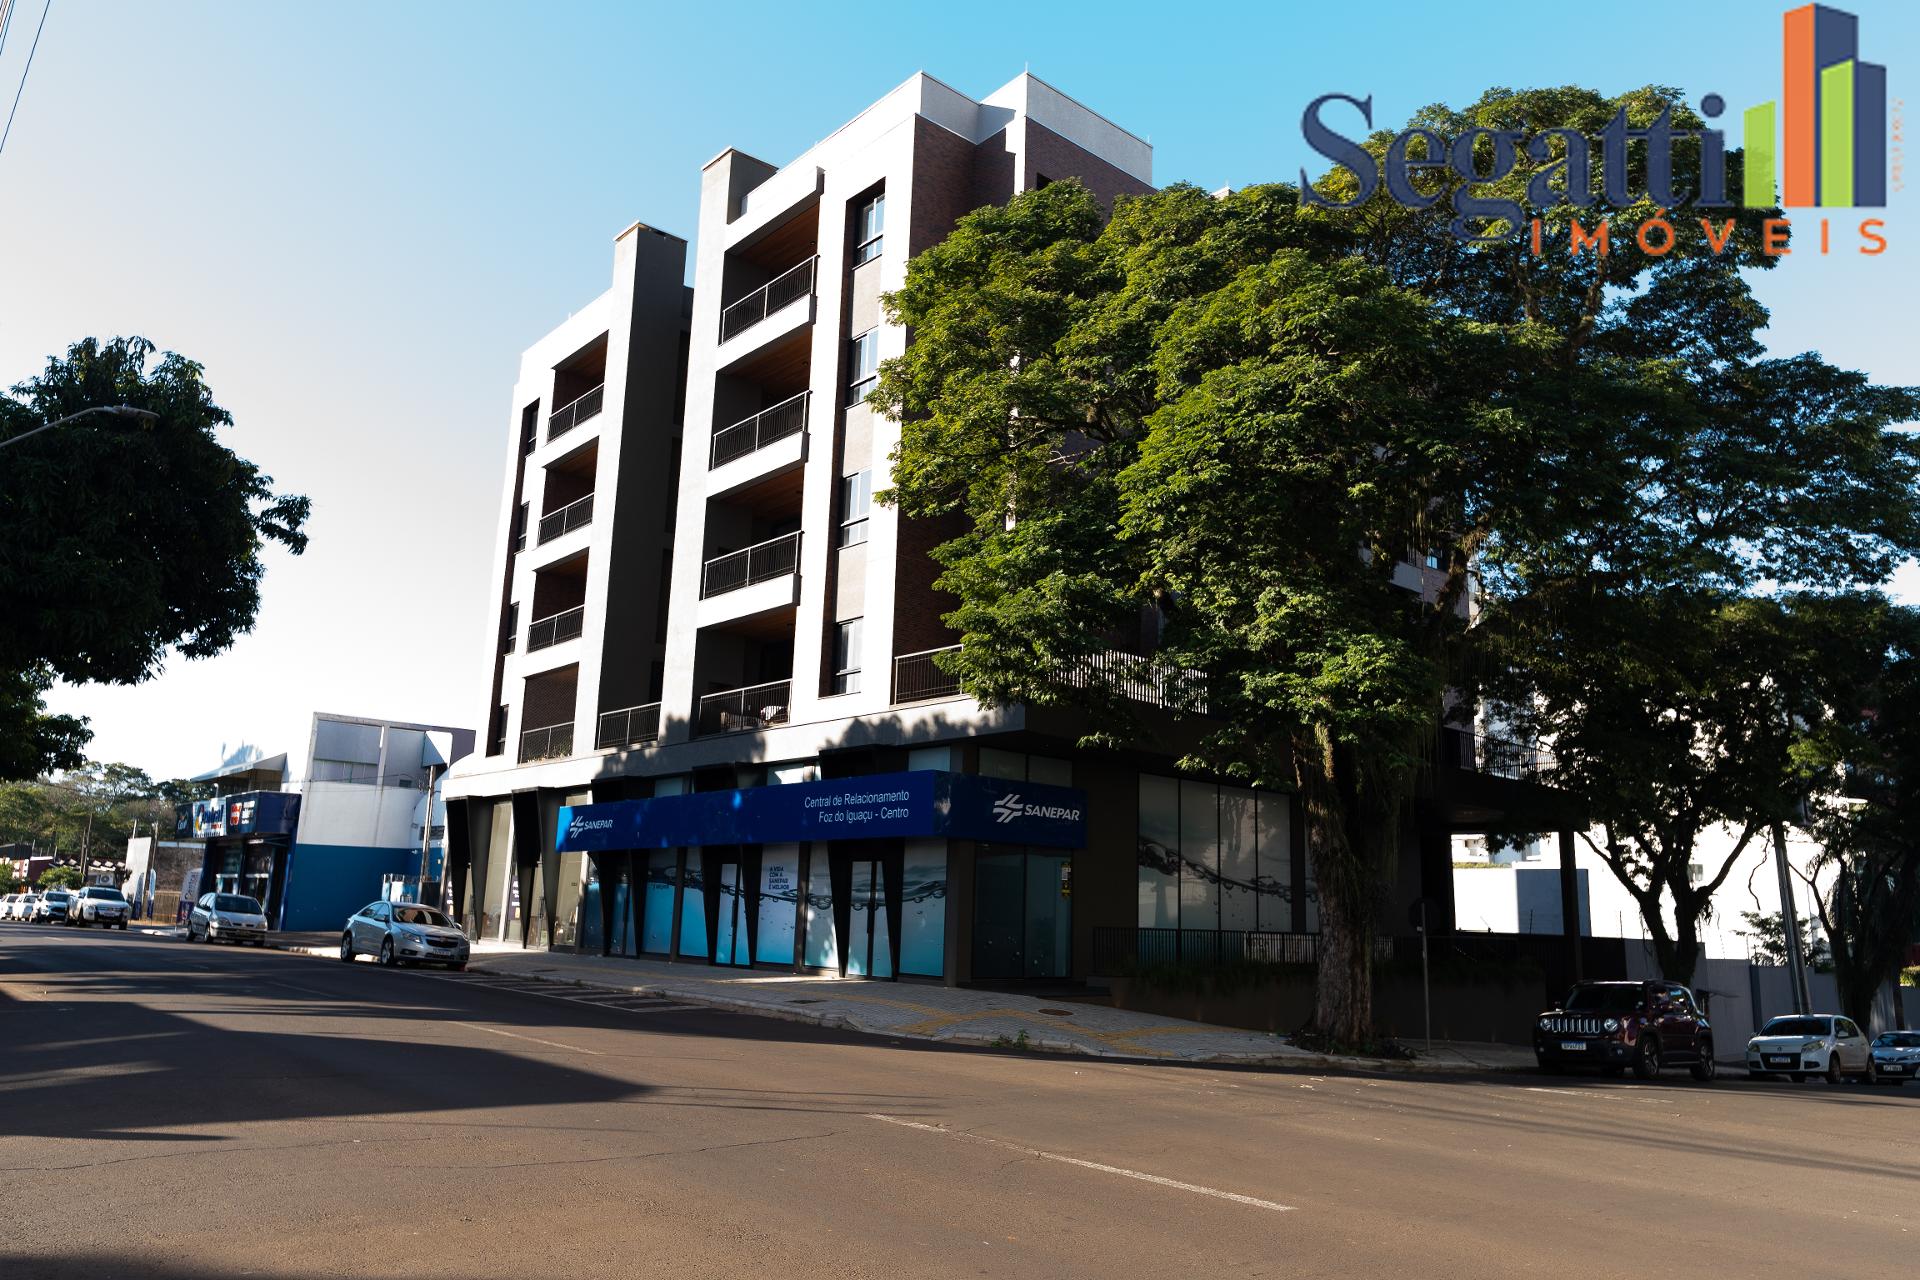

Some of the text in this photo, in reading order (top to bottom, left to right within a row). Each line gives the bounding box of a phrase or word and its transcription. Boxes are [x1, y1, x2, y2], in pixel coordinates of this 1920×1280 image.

[804, 789, 910, 809] Central de Relacionamento
[818, 811, 833, 823] Foz
[834, 810, 844, 822] do
[880, 806, 909, 819] Centro
[1024, 804, 1080, 821] SANEPAR
[584, 819, 614, 831] SANEPAR
